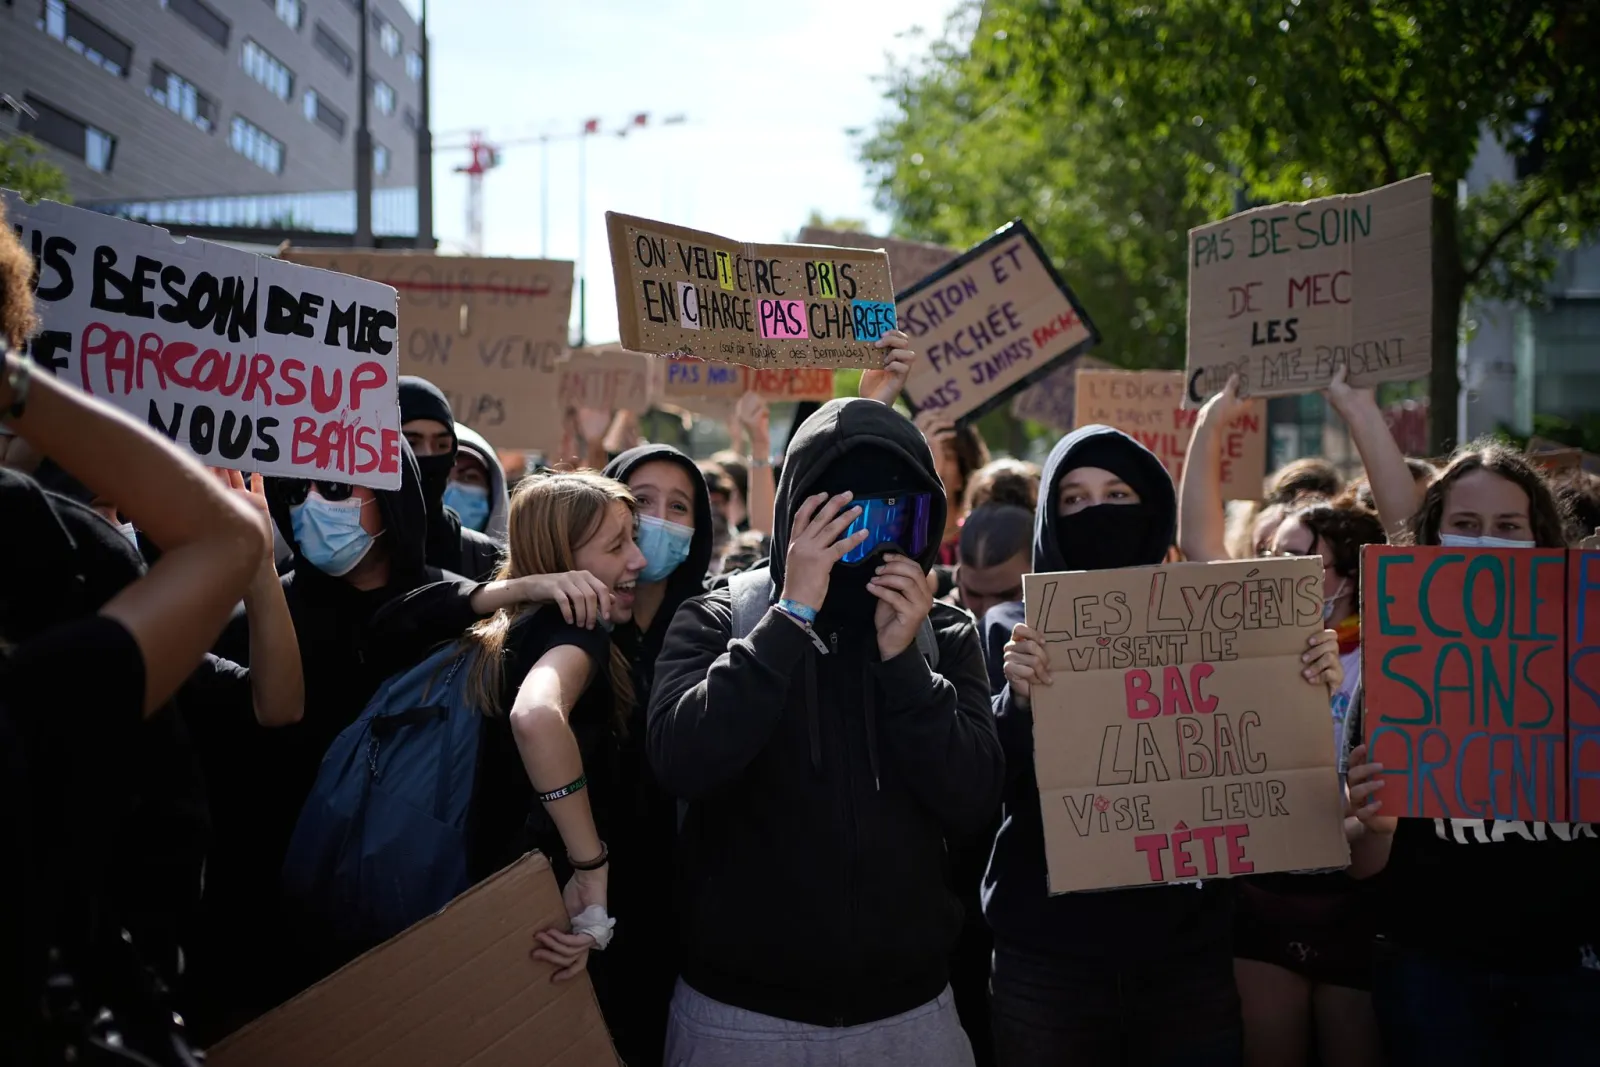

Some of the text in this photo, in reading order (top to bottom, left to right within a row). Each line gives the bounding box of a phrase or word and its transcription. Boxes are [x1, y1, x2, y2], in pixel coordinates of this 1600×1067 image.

[636, 235, 666, 268] ON
[677, 242, 729, 284] VEUT
[805, 260, 857, 300] PRIS
[1194, 205, 1371, 268] PAS BESOIN
[90, 245, 259, 343] BESOIN
[264, 285, 323, 338] DE
[324, 299, 396, 356] MEC
[643, 280, 895, 341] EN CHARGE PAS CHARGÉS
[898, 274, 979, 338] ASHION
[990, 243, 1023, 285] ET
[1228, 271, 1352, 319] DE MEC
[789, 347, 807, 359] des
[926, 301, 1024, 374] FACHÉE
[969, 336, 1034, 385] JAMAIS
[1252, 318, 1298, 347] LES
[80, 321, 388, 413] PARCOURSUP
[148, 399, 279, 462] NOUS
[1173, 408, 1200, 430] PA
[1036, 569, 1324, 642] LES LYCÉENS
[1377, 554, 1565, 641] ECOLE
[1201, 631, 1238, 662] LE
[1124, 663, 1219, 719] BAC
[1381, 642, 1555, 729] SANS
[1097, 711, 1267, 786] LA BAC
[1367, 726, 1565, 821] ARGENT
[545, 788, 569, 801] FREE
[1202, 780, 1290, 821] LEUR
[1134, 820, 1254, 881] TÊTE
